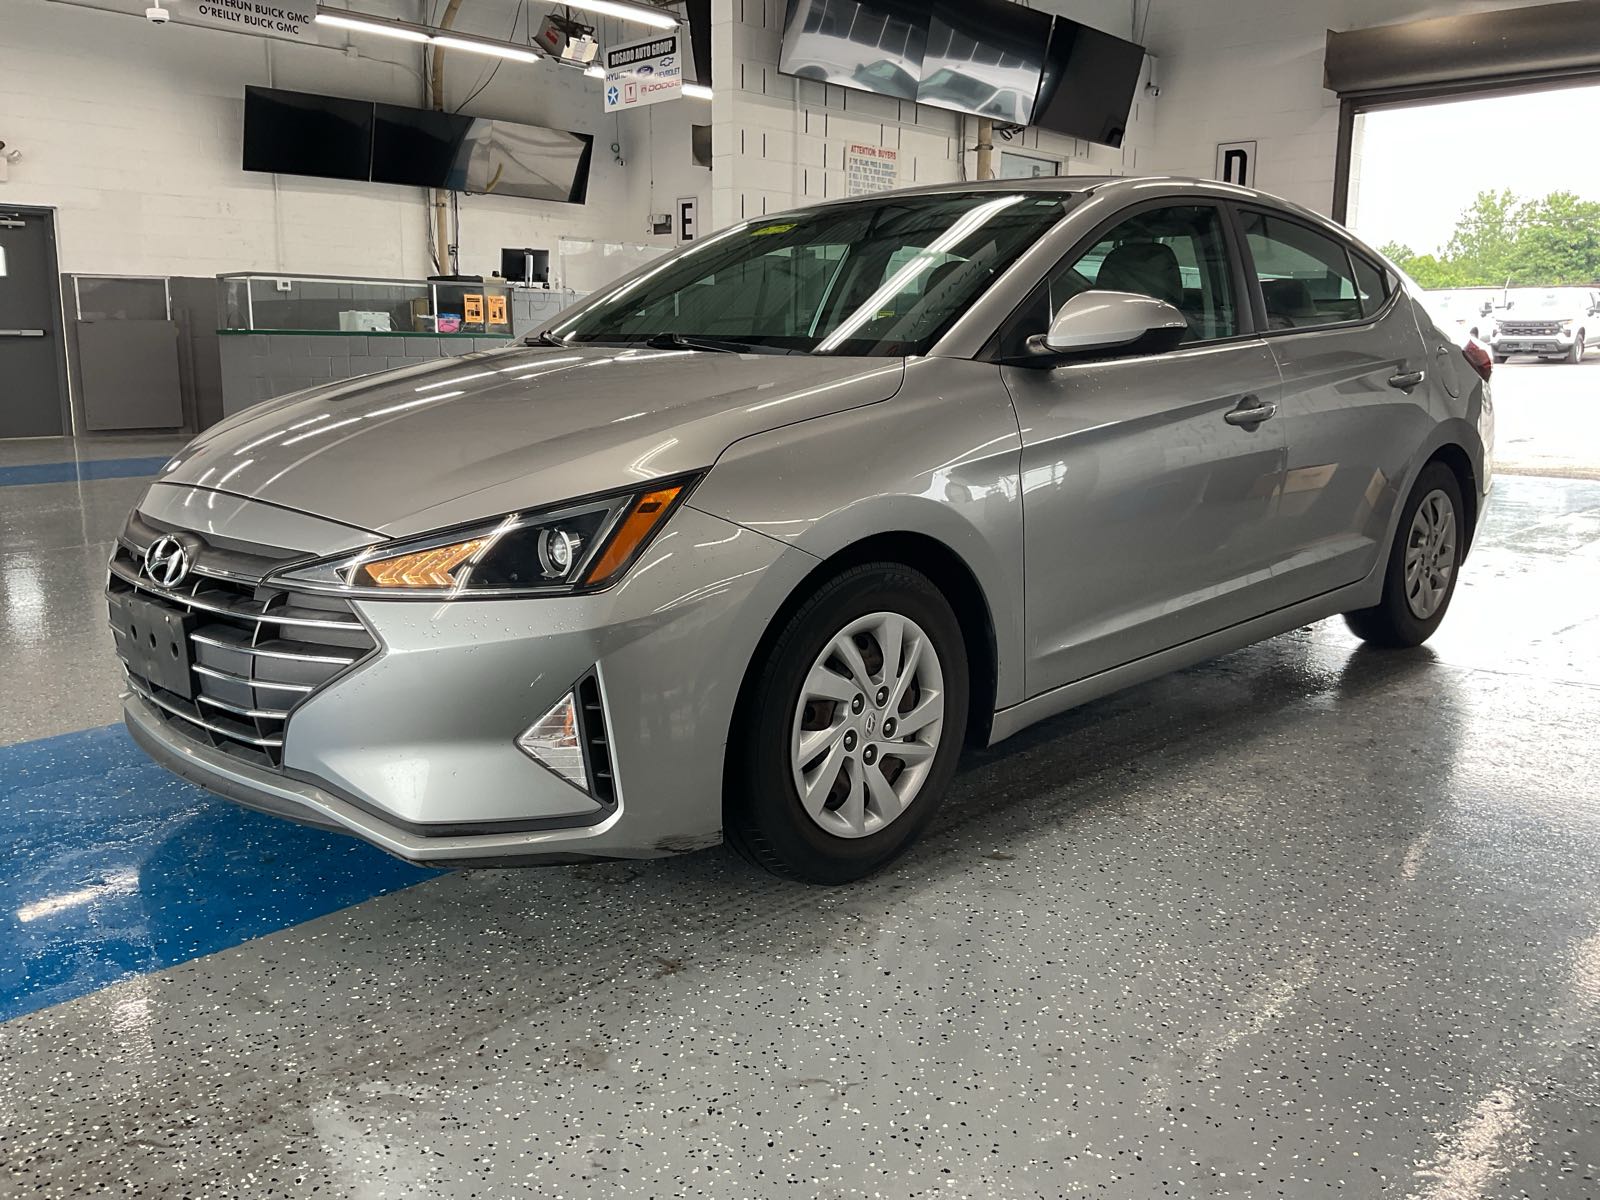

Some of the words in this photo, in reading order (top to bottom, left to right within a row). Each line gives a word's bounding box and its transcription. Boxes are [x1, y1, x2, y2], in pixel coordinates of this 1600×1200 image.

[199, 5, 241, 22] O'REILLY
[244, 15, 274, 29] BUICK
[276, 22, 299, 34] GMC
[255, 4, 284, 19] BUICK
[287, 11, 310, 24] GMC
[635, 45, 651, 60] AUTO
[651, 40, 673, 55] GROUP
[648, 80, 680, 92] DODGE
[878, 149, 896, 160] BUYERS
[1223, 149, 1248, 187] D
[682, 202, 693, 241] E
